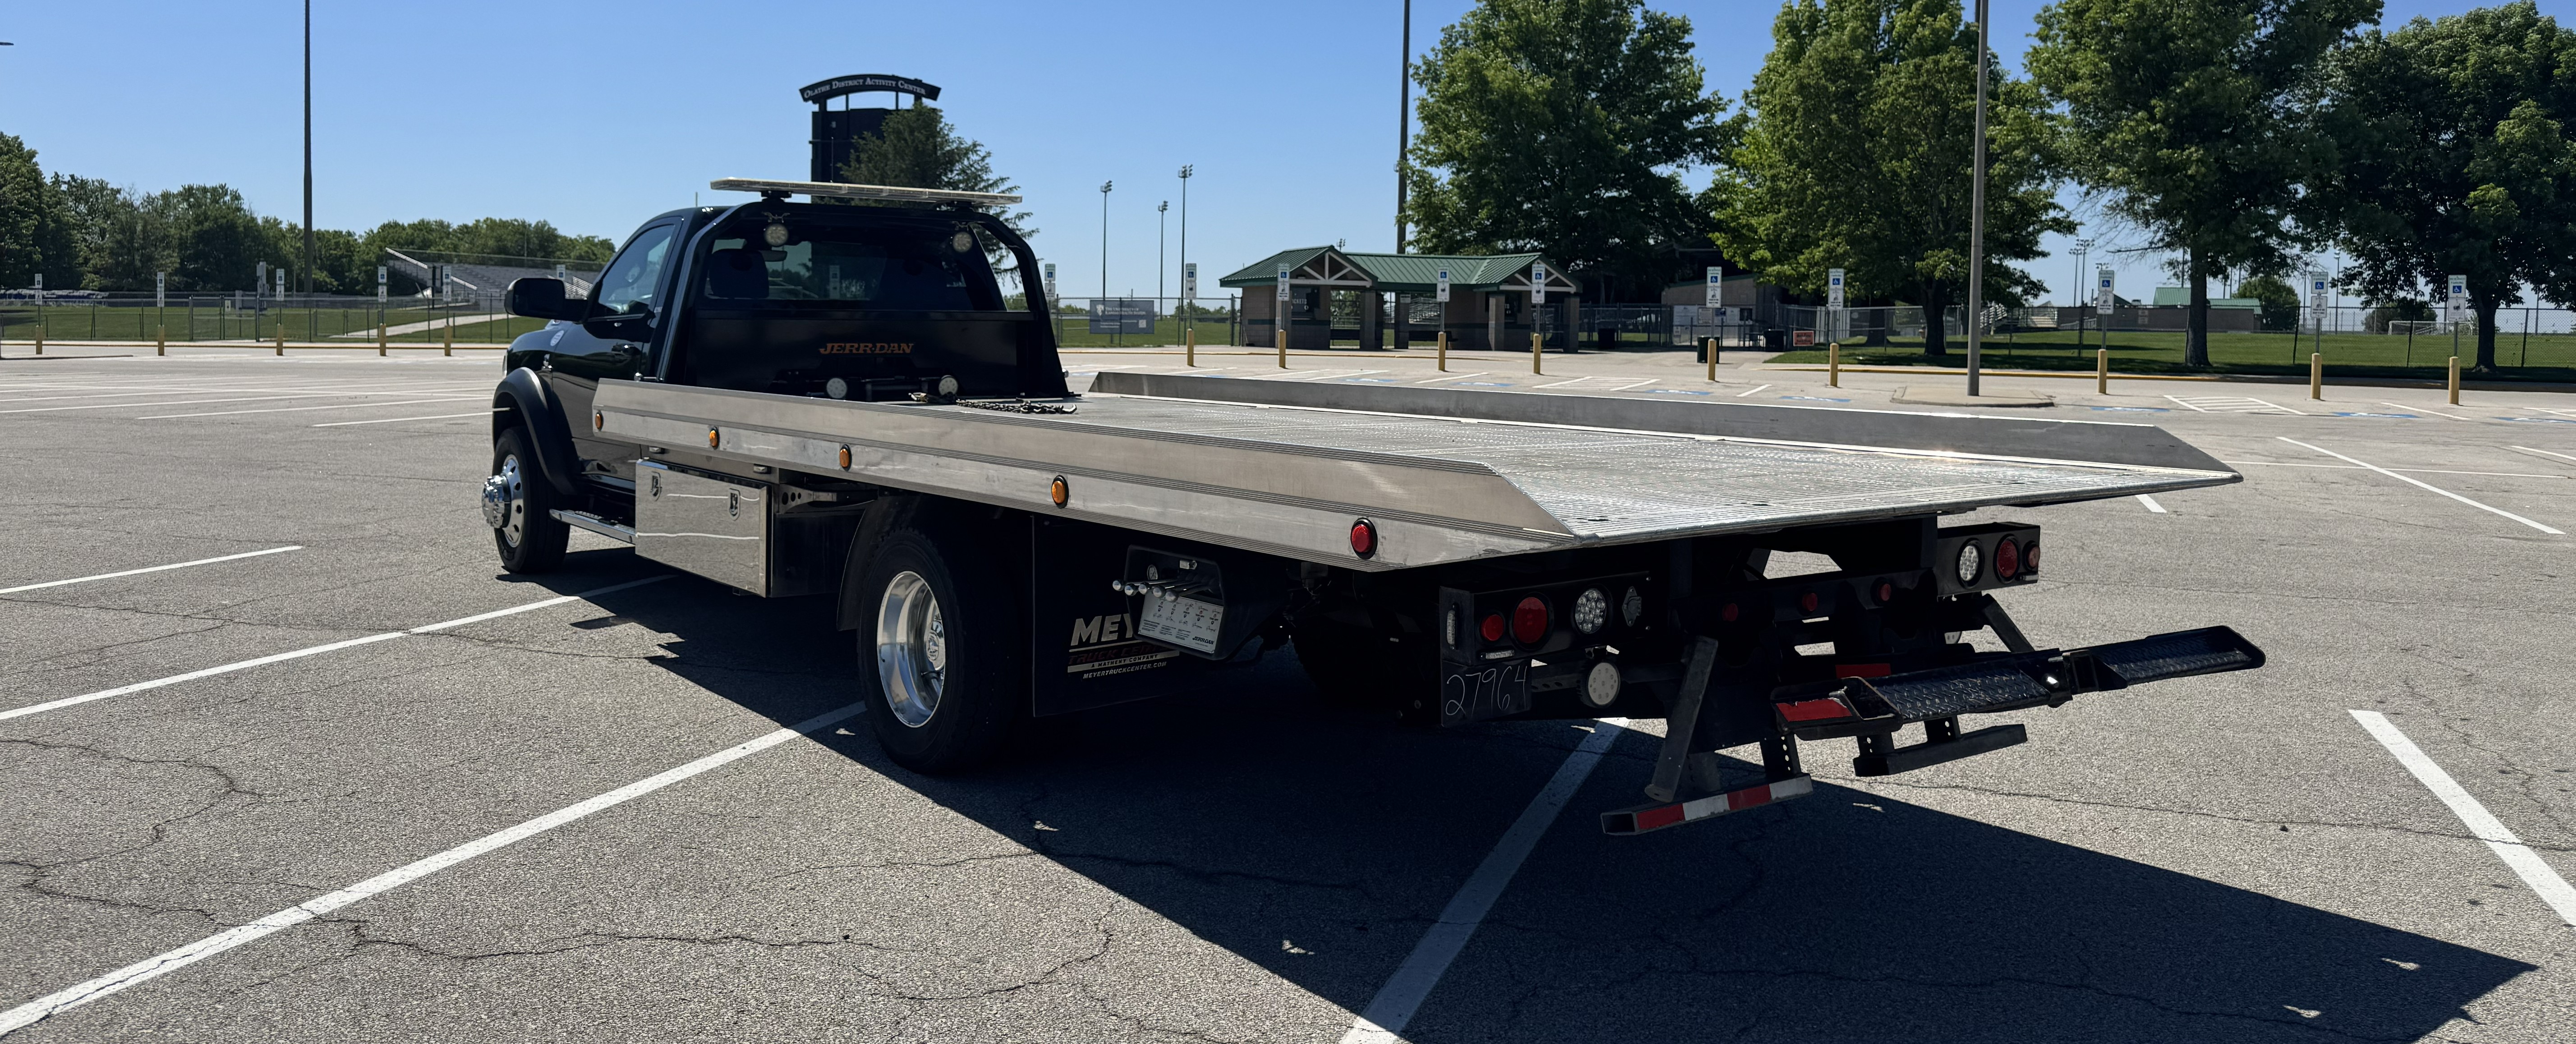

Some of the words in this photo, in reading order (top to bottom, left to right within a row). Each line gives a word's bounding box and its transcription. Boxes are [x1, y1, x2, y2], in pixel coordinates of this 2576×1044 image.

[804, 84, 830, 98] OLATHE
[832, 79, 863, 89] DISTRICT
[865, 77, 896, 87] ACTIVITY
[898, 81, 926, 95] CENTER
[1070, 613, 1133, 646] MEY
[1098, 659, 1126, 667] MATHENY
[1129, 654, 1158, 662] COMPANY
[1083, 662, 1167, 679] MEYERTRUCKCENTER.COM
